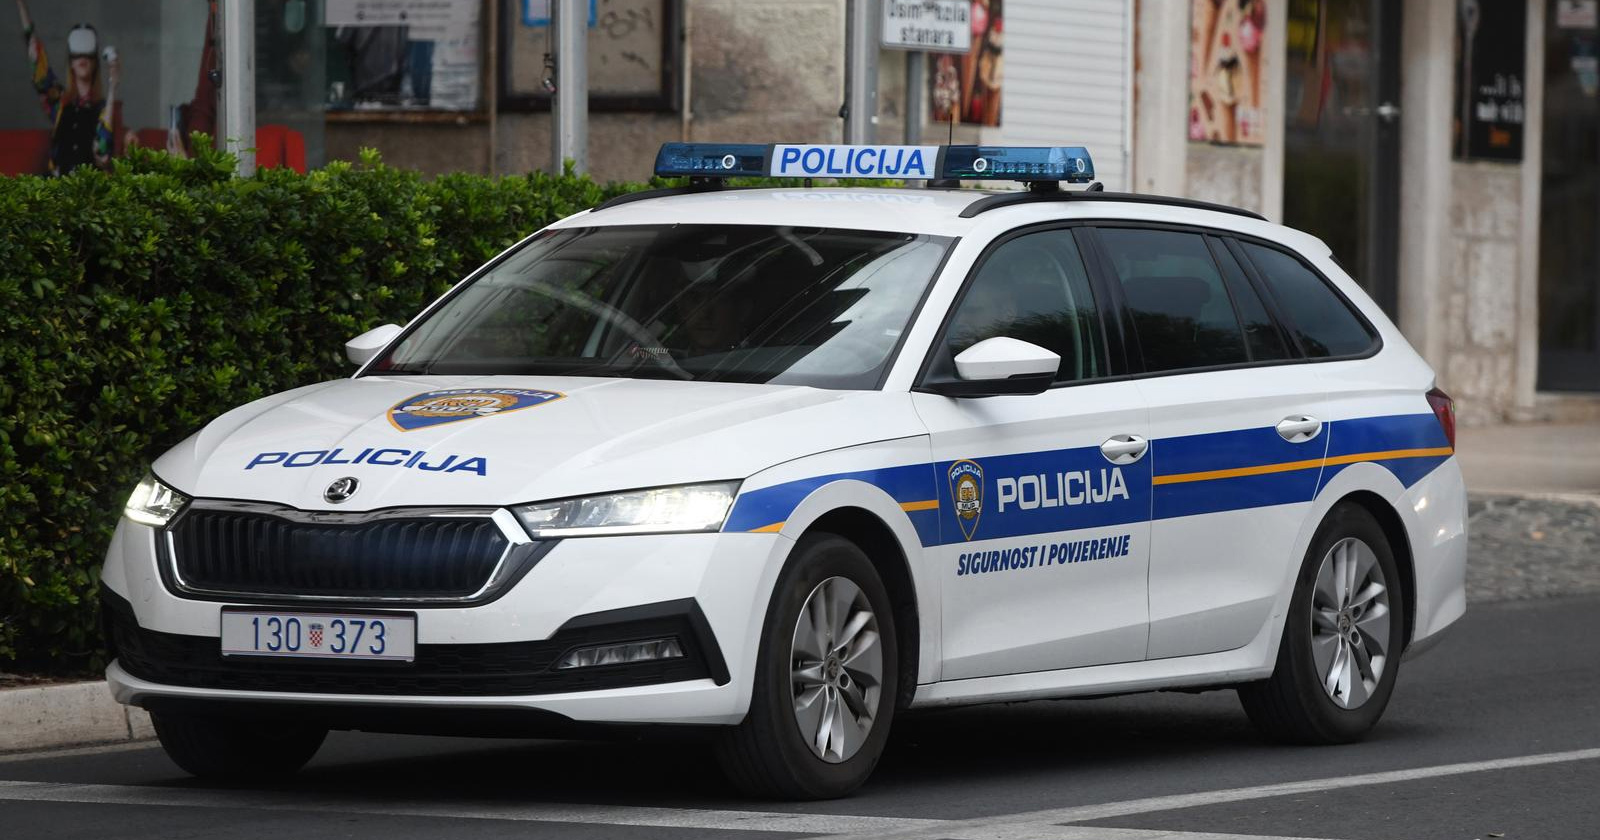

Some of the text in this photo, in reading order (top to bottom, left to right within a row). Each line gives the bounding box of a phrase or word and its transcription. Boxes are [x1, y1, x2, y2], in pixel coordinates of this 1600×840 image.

[780, 147, 926, 175] POLICIJA
[244, 447, 487, 477] POLICIJA
[950, 464, 982, 480] POLICIJA
[996, 467, 1130, 513] POLICIJA
[961, 502, 976, 511] MUP
[957, 534, 1131, 576] SIGURNOST I POVJERENJE
[252, 617, 385, 654] 130 373
